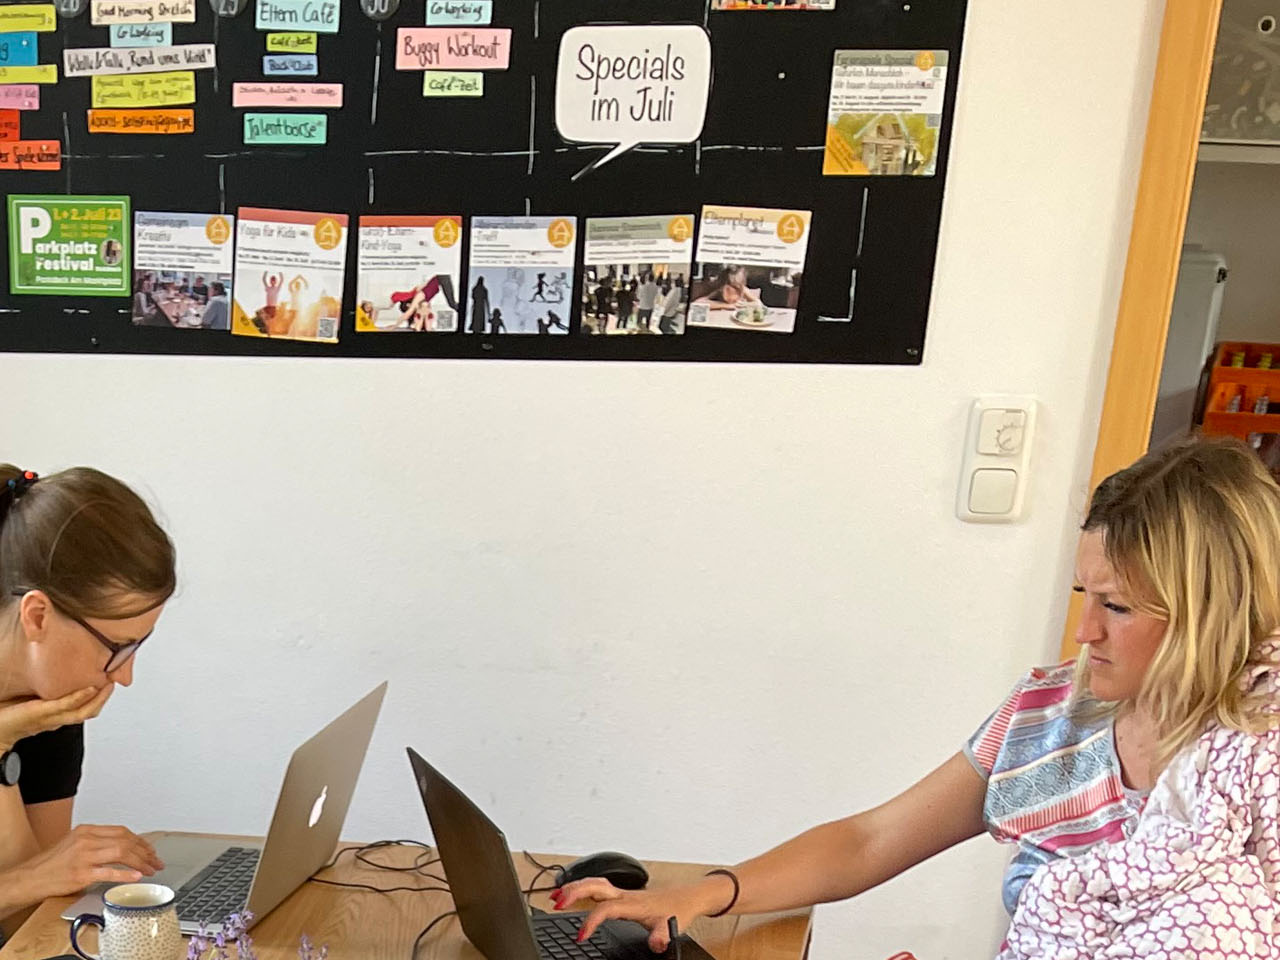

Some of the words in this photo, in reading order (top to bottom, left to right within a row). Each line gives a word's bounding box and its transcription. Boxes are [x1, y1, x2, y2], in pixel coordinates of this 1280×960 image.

[404, 36, 440, 67] Buggy
[447, 34, 501, 59] Workout
[576, 43, 685, 95] Specials
[591, 97, 619, 121] im
[630, 85, 675, 121] Juli
